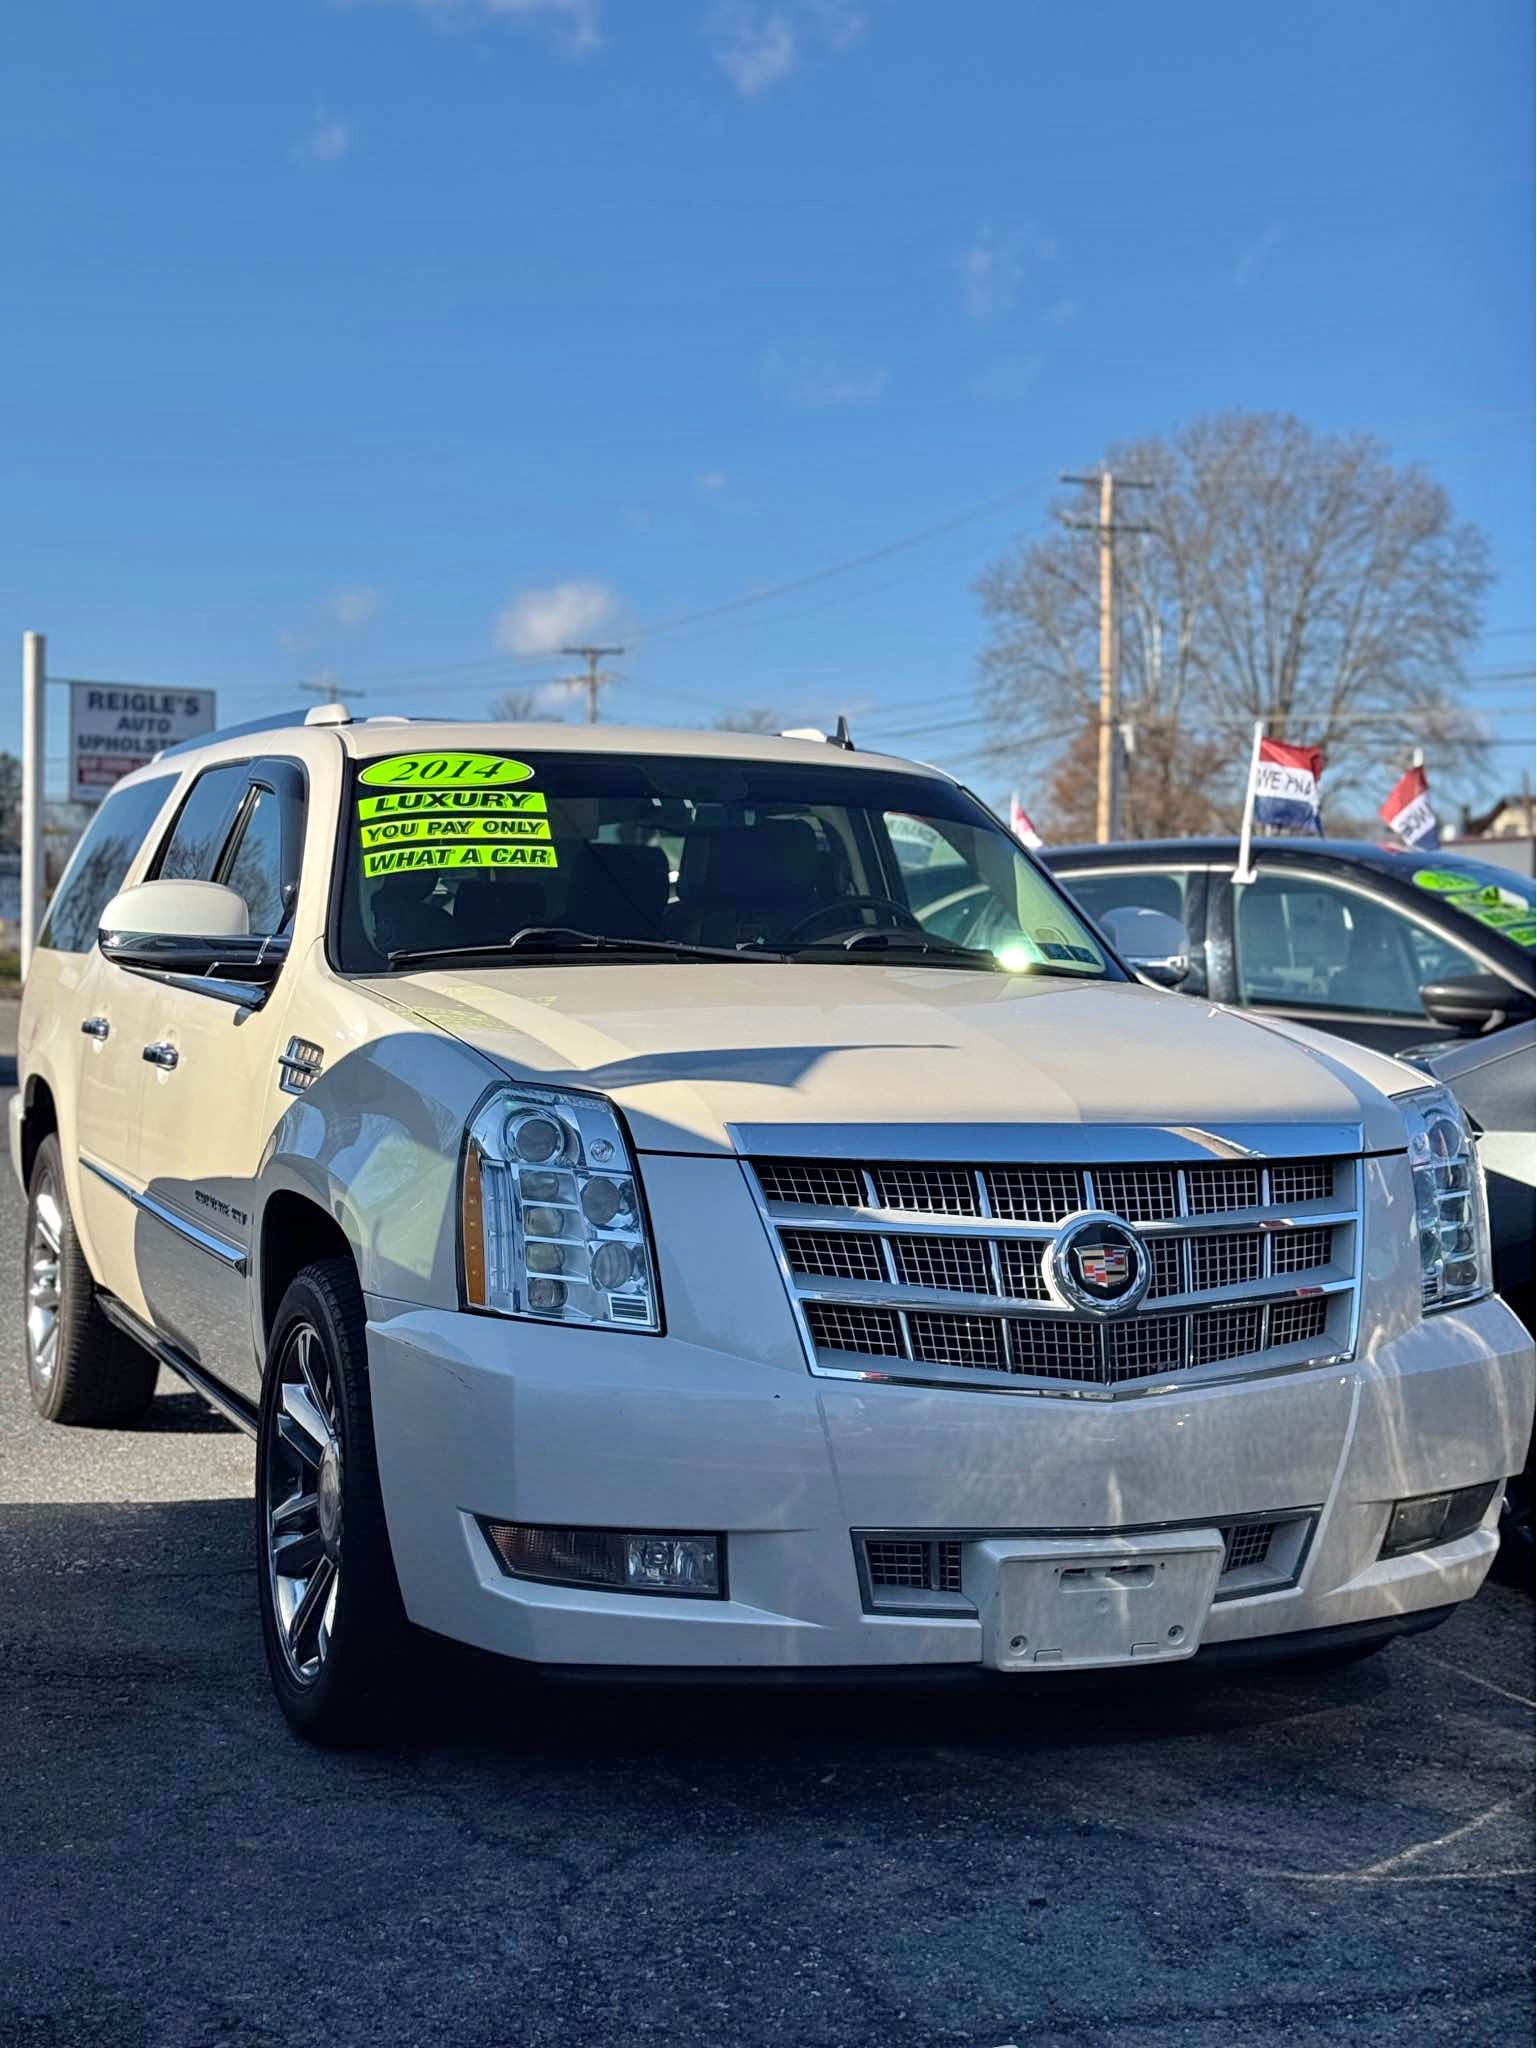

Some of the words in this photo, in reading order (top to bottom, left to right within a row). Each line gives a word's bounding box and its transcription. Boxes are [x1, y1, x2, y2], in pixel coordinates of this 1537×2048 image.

[88, 691, 200, 716] REIGLE'S
[117, 716, 171, 733] AUTO
[388, 760, 505, 782] 2014
[375, 792, 534, 813] LUXURY
[367, 822, 418, 842] YOU
[427, 820, 475, 836] PAY
[482, 820, 544, 836] ONLY
[369, 849, 455, 873] WHAT
[460, 848, 483, 865] A
[490, 848, 551, 865] CAR
